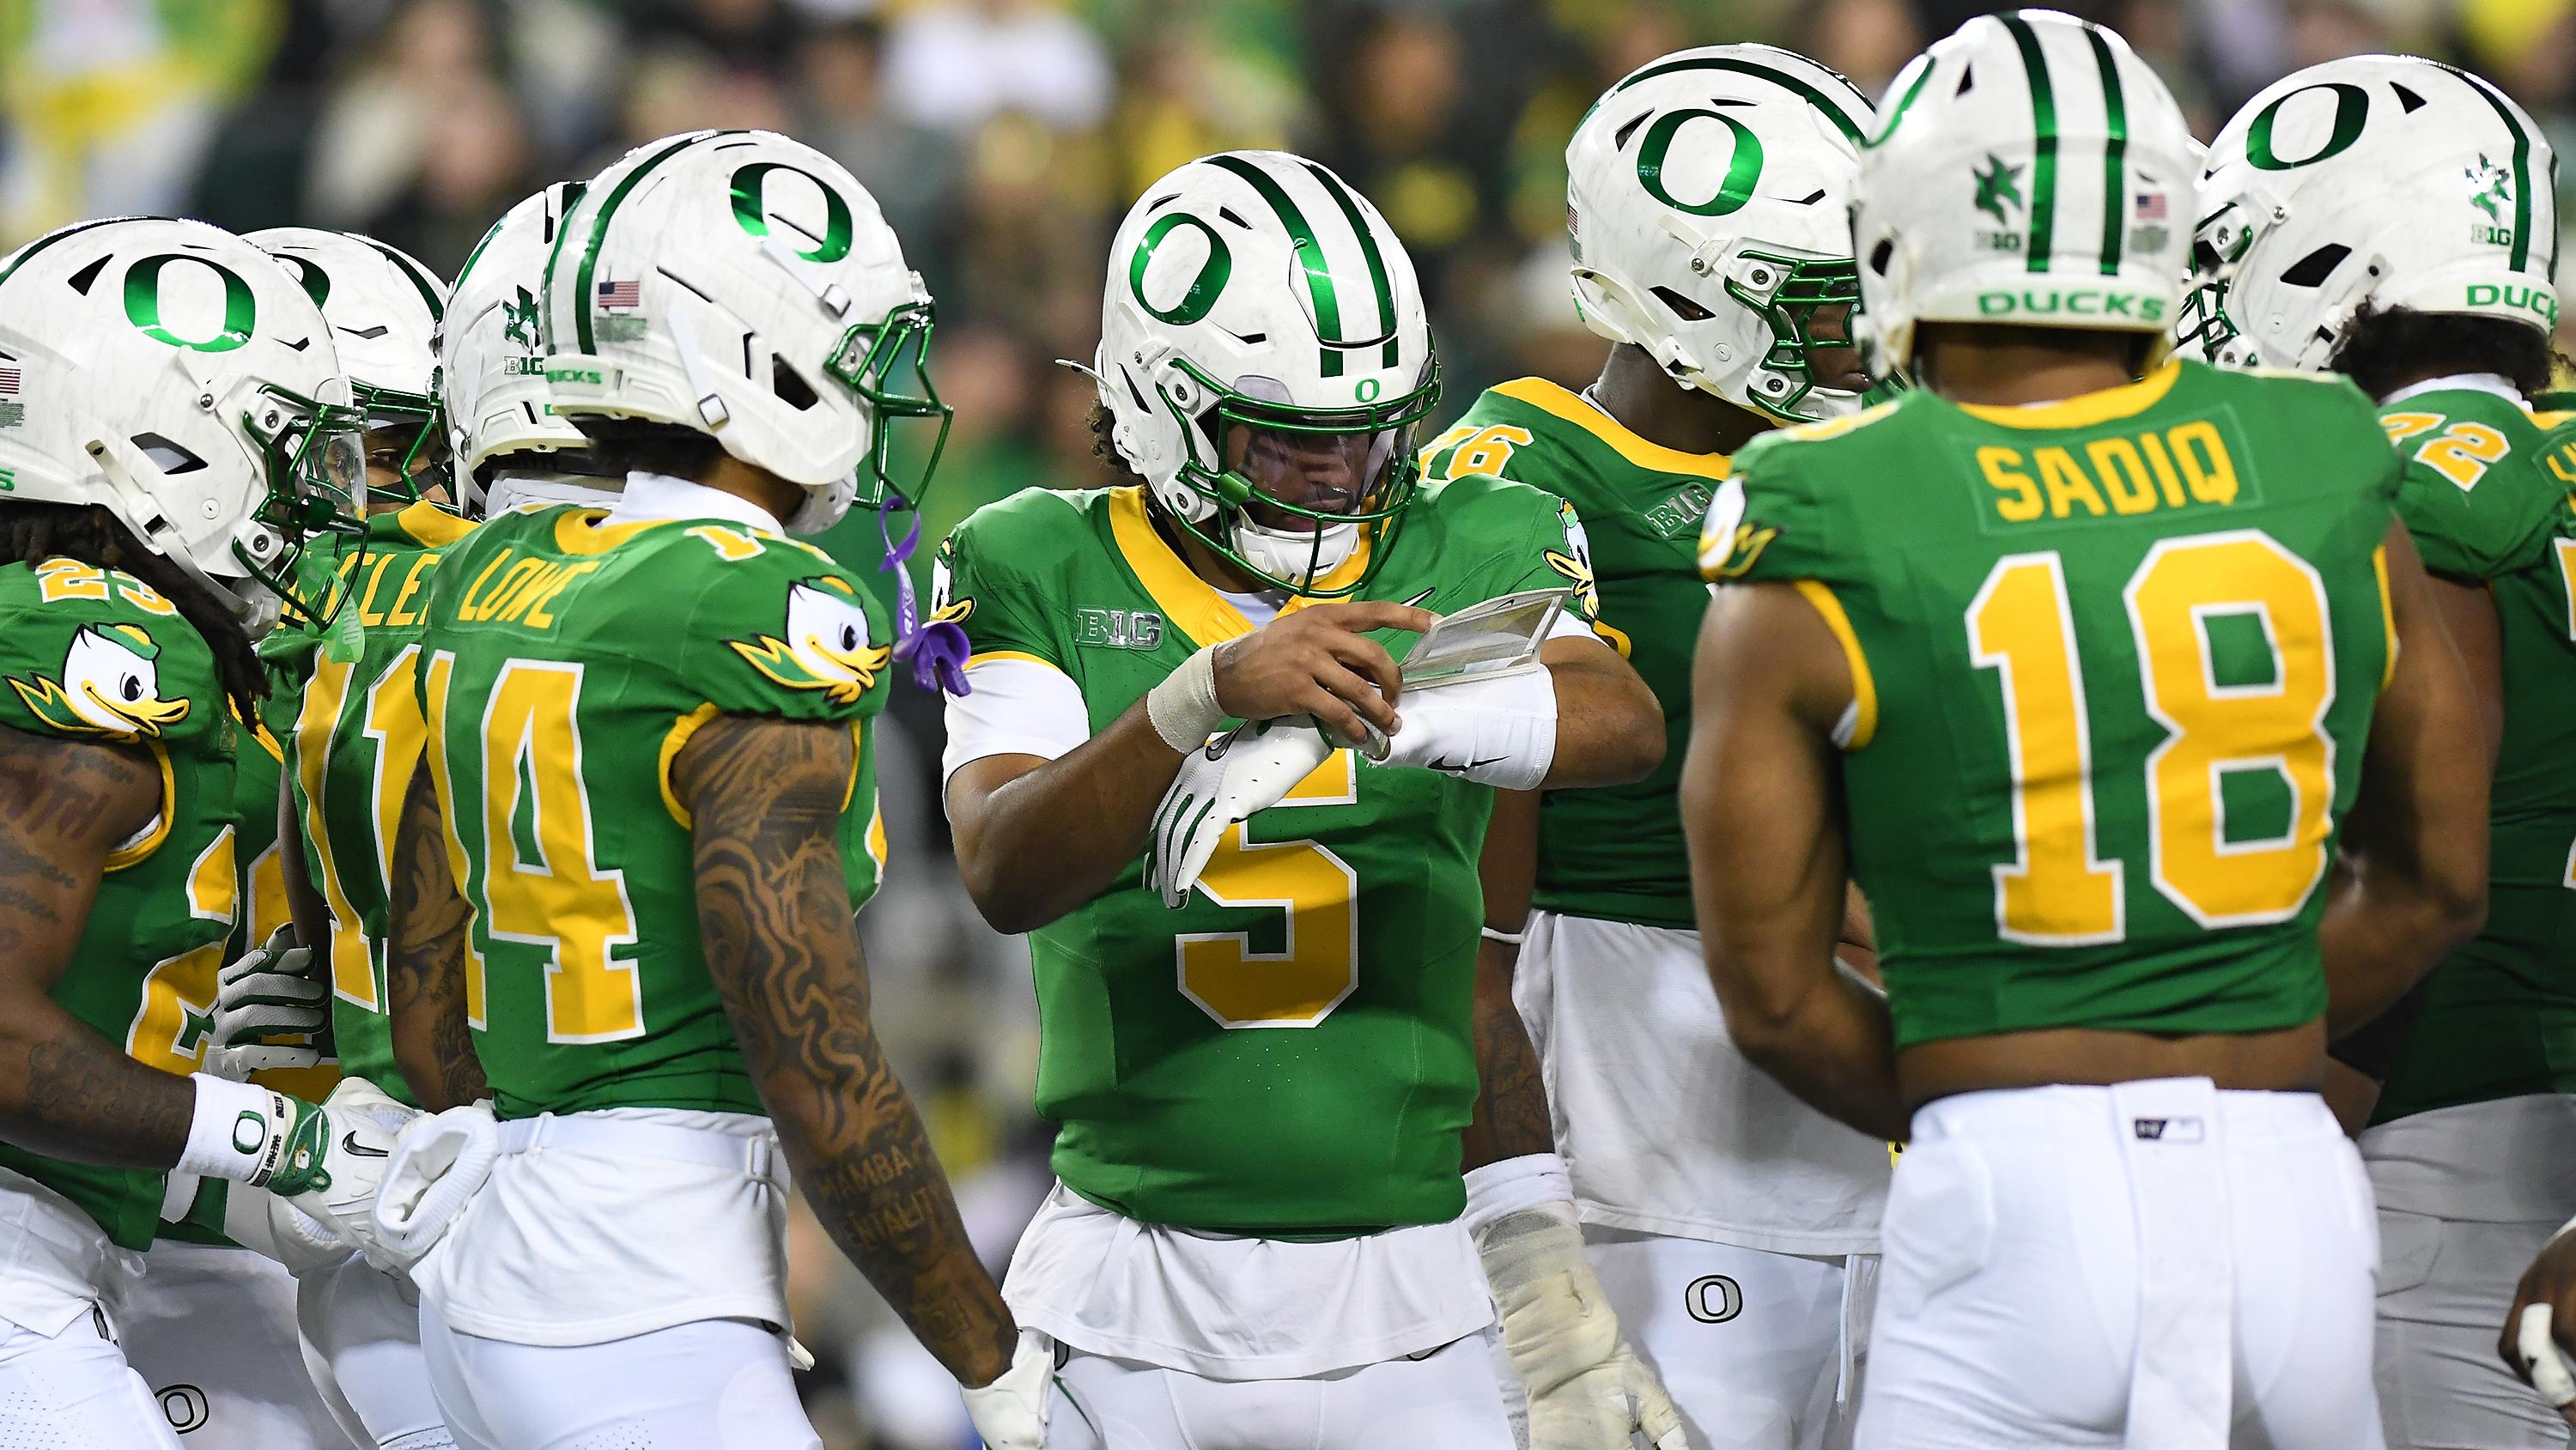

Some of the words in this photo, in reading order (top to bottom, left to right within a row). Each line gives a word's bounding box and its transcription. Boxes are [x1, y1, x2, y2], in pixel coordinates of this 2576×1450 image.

[1978, 291, 2166, 322] DUCKS
[1976, 420, 2241, 523] SADIQ
[457, 548, 601, 629] LOWE
[1964, 528, 2336, 947] 18
[425, 648, 647, 1044] 14
[1173, 731, 1358, 1030] 5
